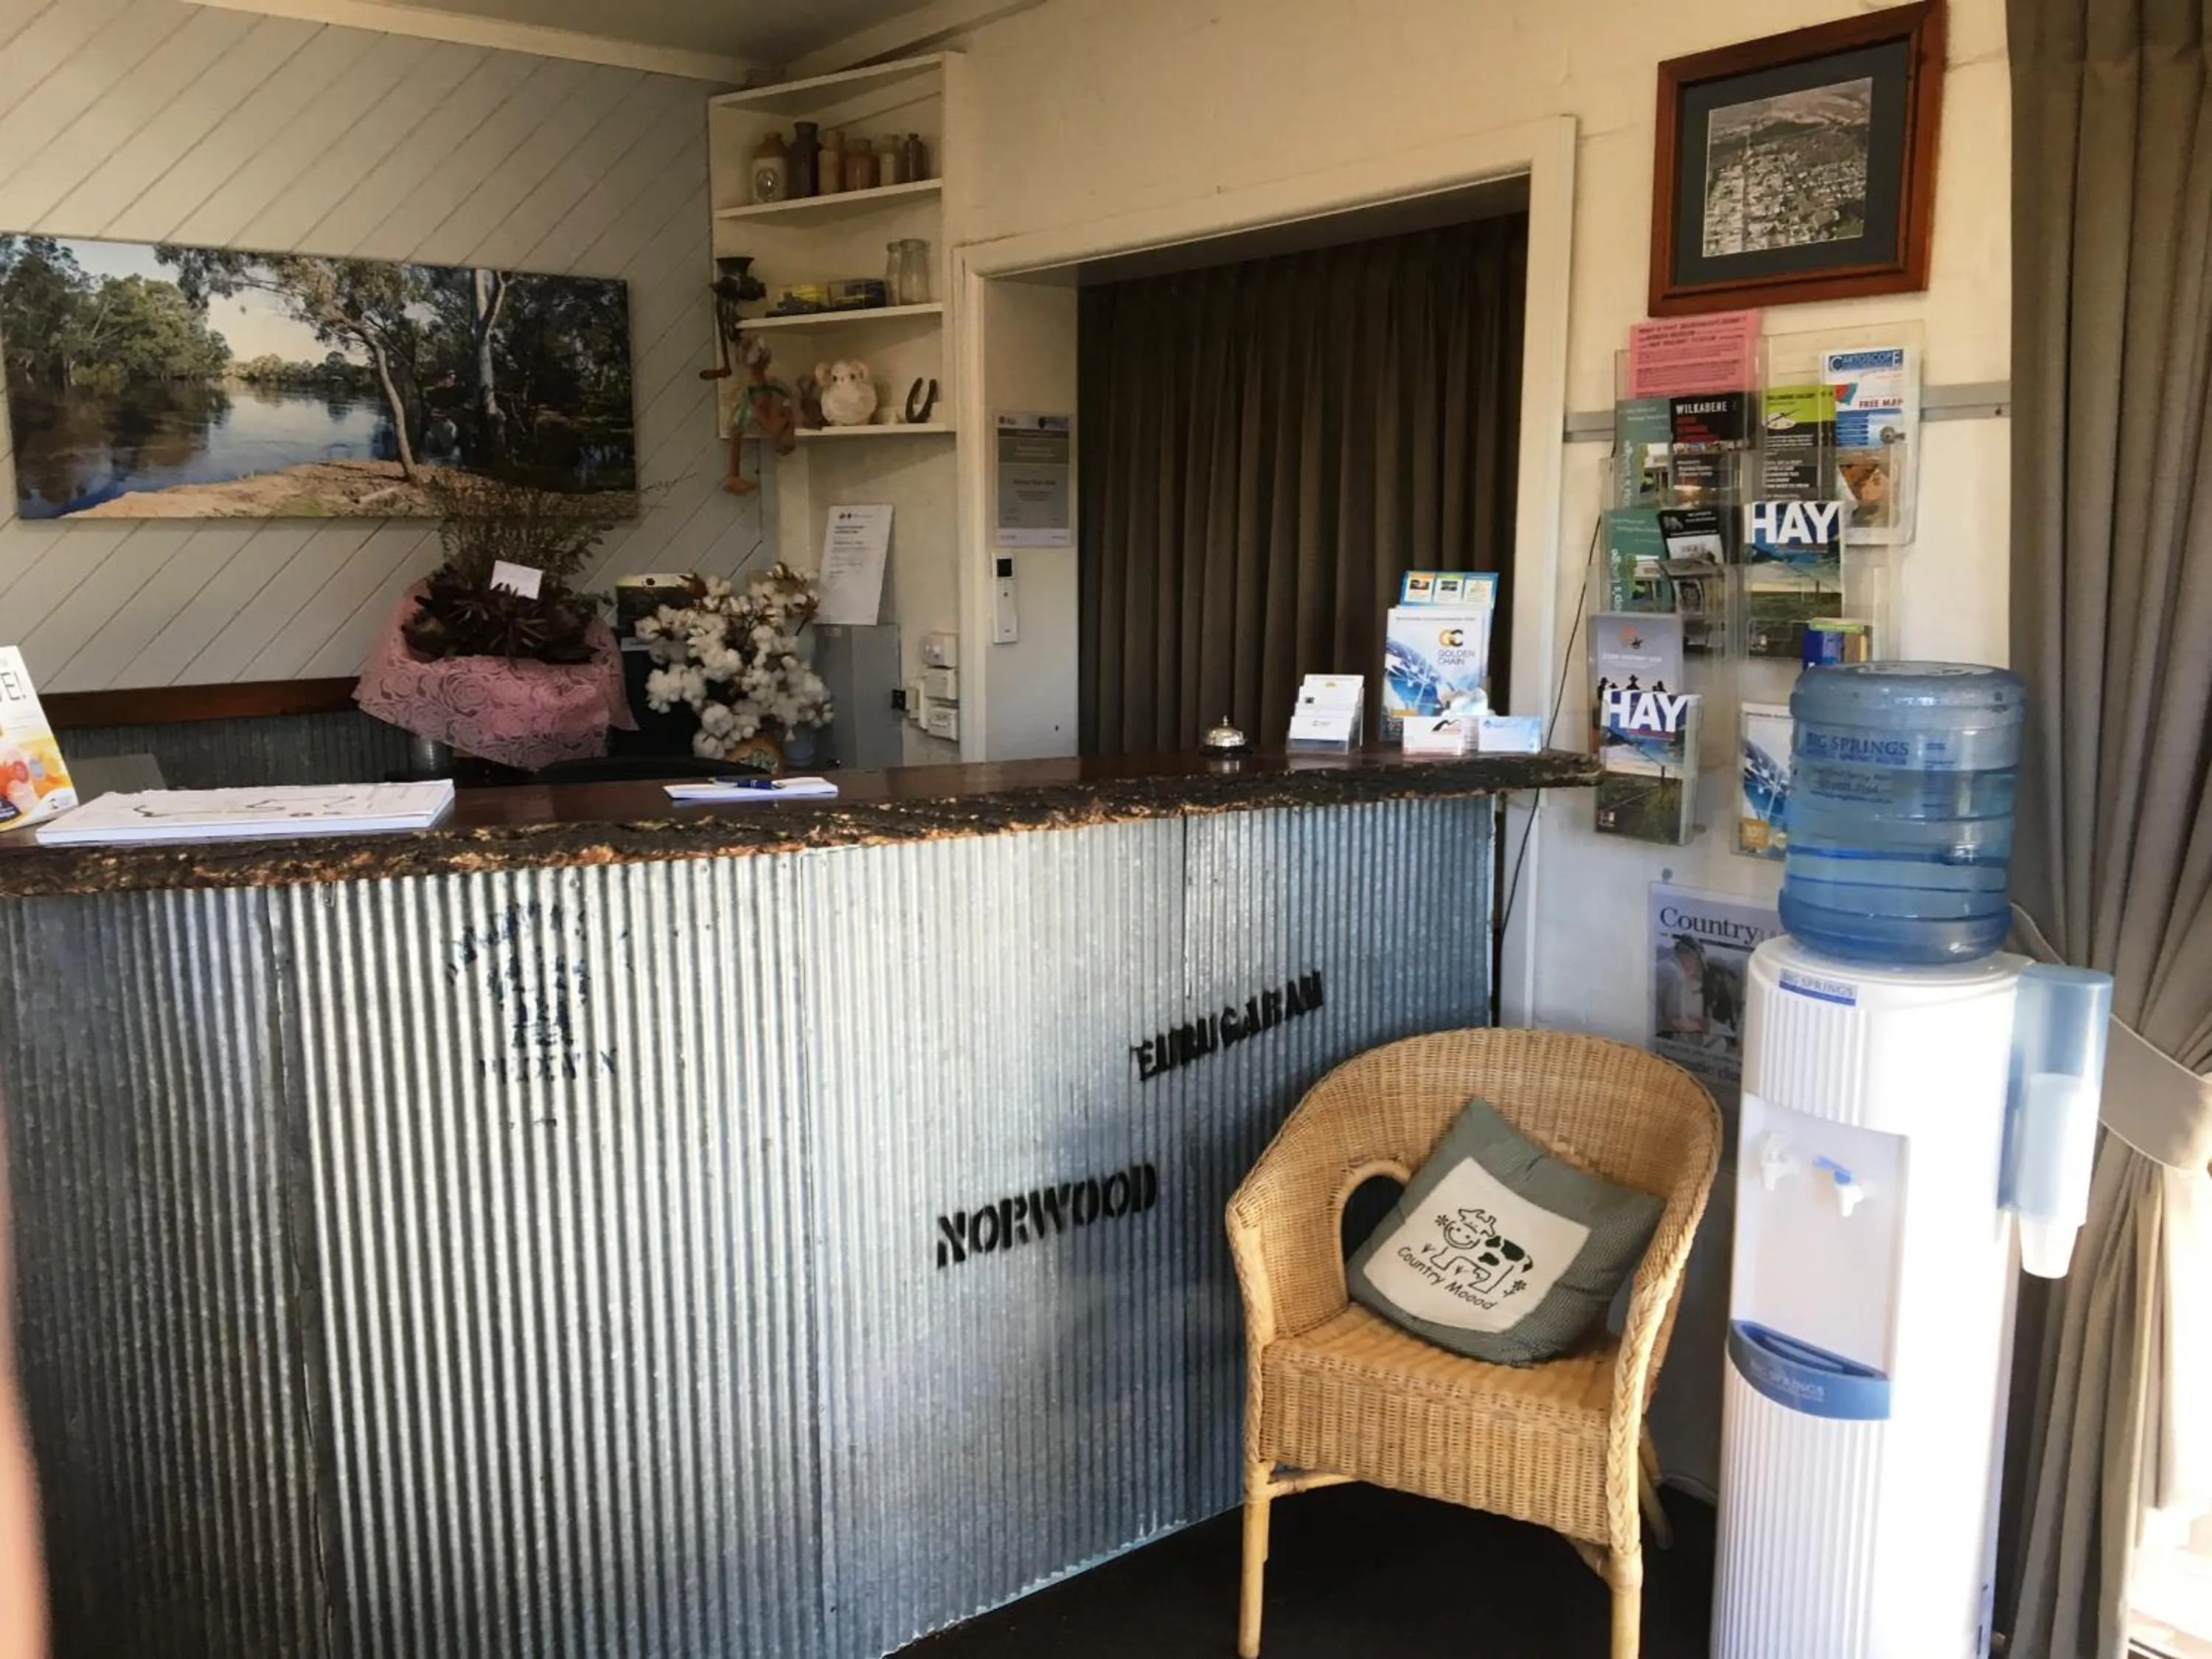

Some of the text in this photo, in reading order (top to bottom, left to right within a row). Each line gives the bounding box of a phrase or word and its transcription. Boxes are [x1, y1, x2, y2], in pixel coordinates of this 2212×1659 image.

[1745, 501, 1843, 543] HAY
[1439, 650, 1475, 658] GOLDEN
[1601, 689, 1688, 731] HAY
[1831, 735, 1910, 756] SPRINGS
[1660, 906, 1759, 945] Country
[1801, 977, 1854, 997] SPRINGS
[937, 1163, 1158, 1269] NORWOOD
[1397, 1246, 1445, 1286] Country
